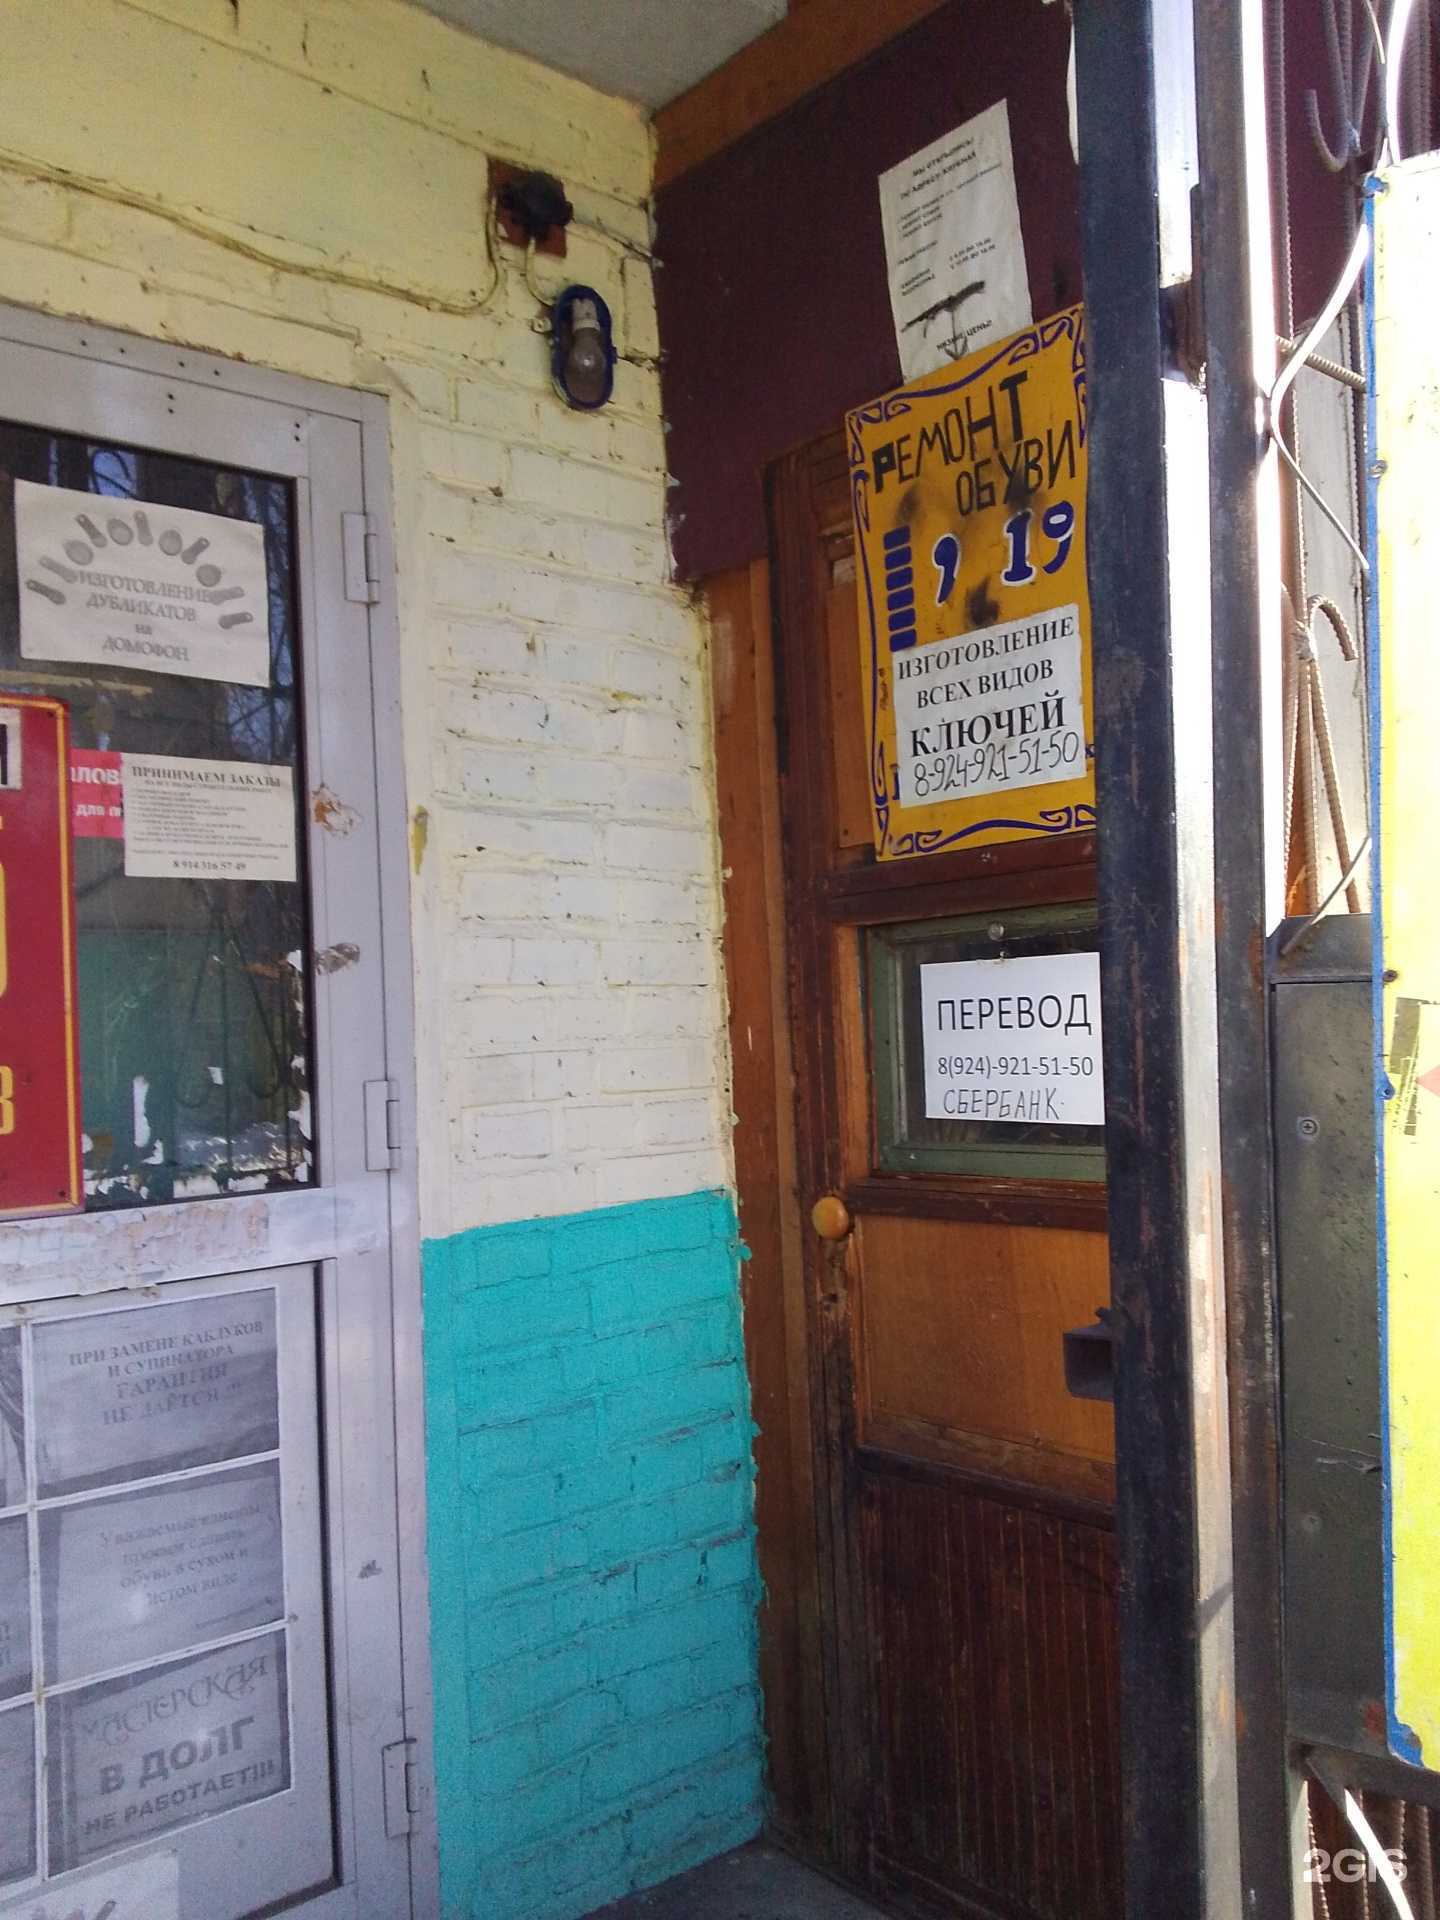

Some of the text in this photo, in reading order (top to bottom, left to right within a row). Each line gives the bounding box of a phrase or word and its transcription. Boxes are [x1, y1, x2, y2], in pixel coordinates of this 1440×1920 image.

[872, 370, 1028, 494] РЕМОНТ
[956, 419, 1076, 516] ОБУВИ
[102, 636, 190, 662] ДОМОФОН
[899, 616, 1075, 680] ИЗГОТОВЛЕНИЕ
[917, 678, 972, 709] ВСЕХ
[978, 658, 1054, 695] ВИДОВ
[911, 689, 1067, 757] КЛЮЧЕЙ
[914, 730, 1080, 797] 8-924-921-51-50
[938, 994, 1092, 1036] ПЕРЕВОД
[938, 1055, 1094, 1079] 8(924)-921-51-50
[101, 1763, 125, 1795] В
[85, 1811, 117, 1835] НЕ
